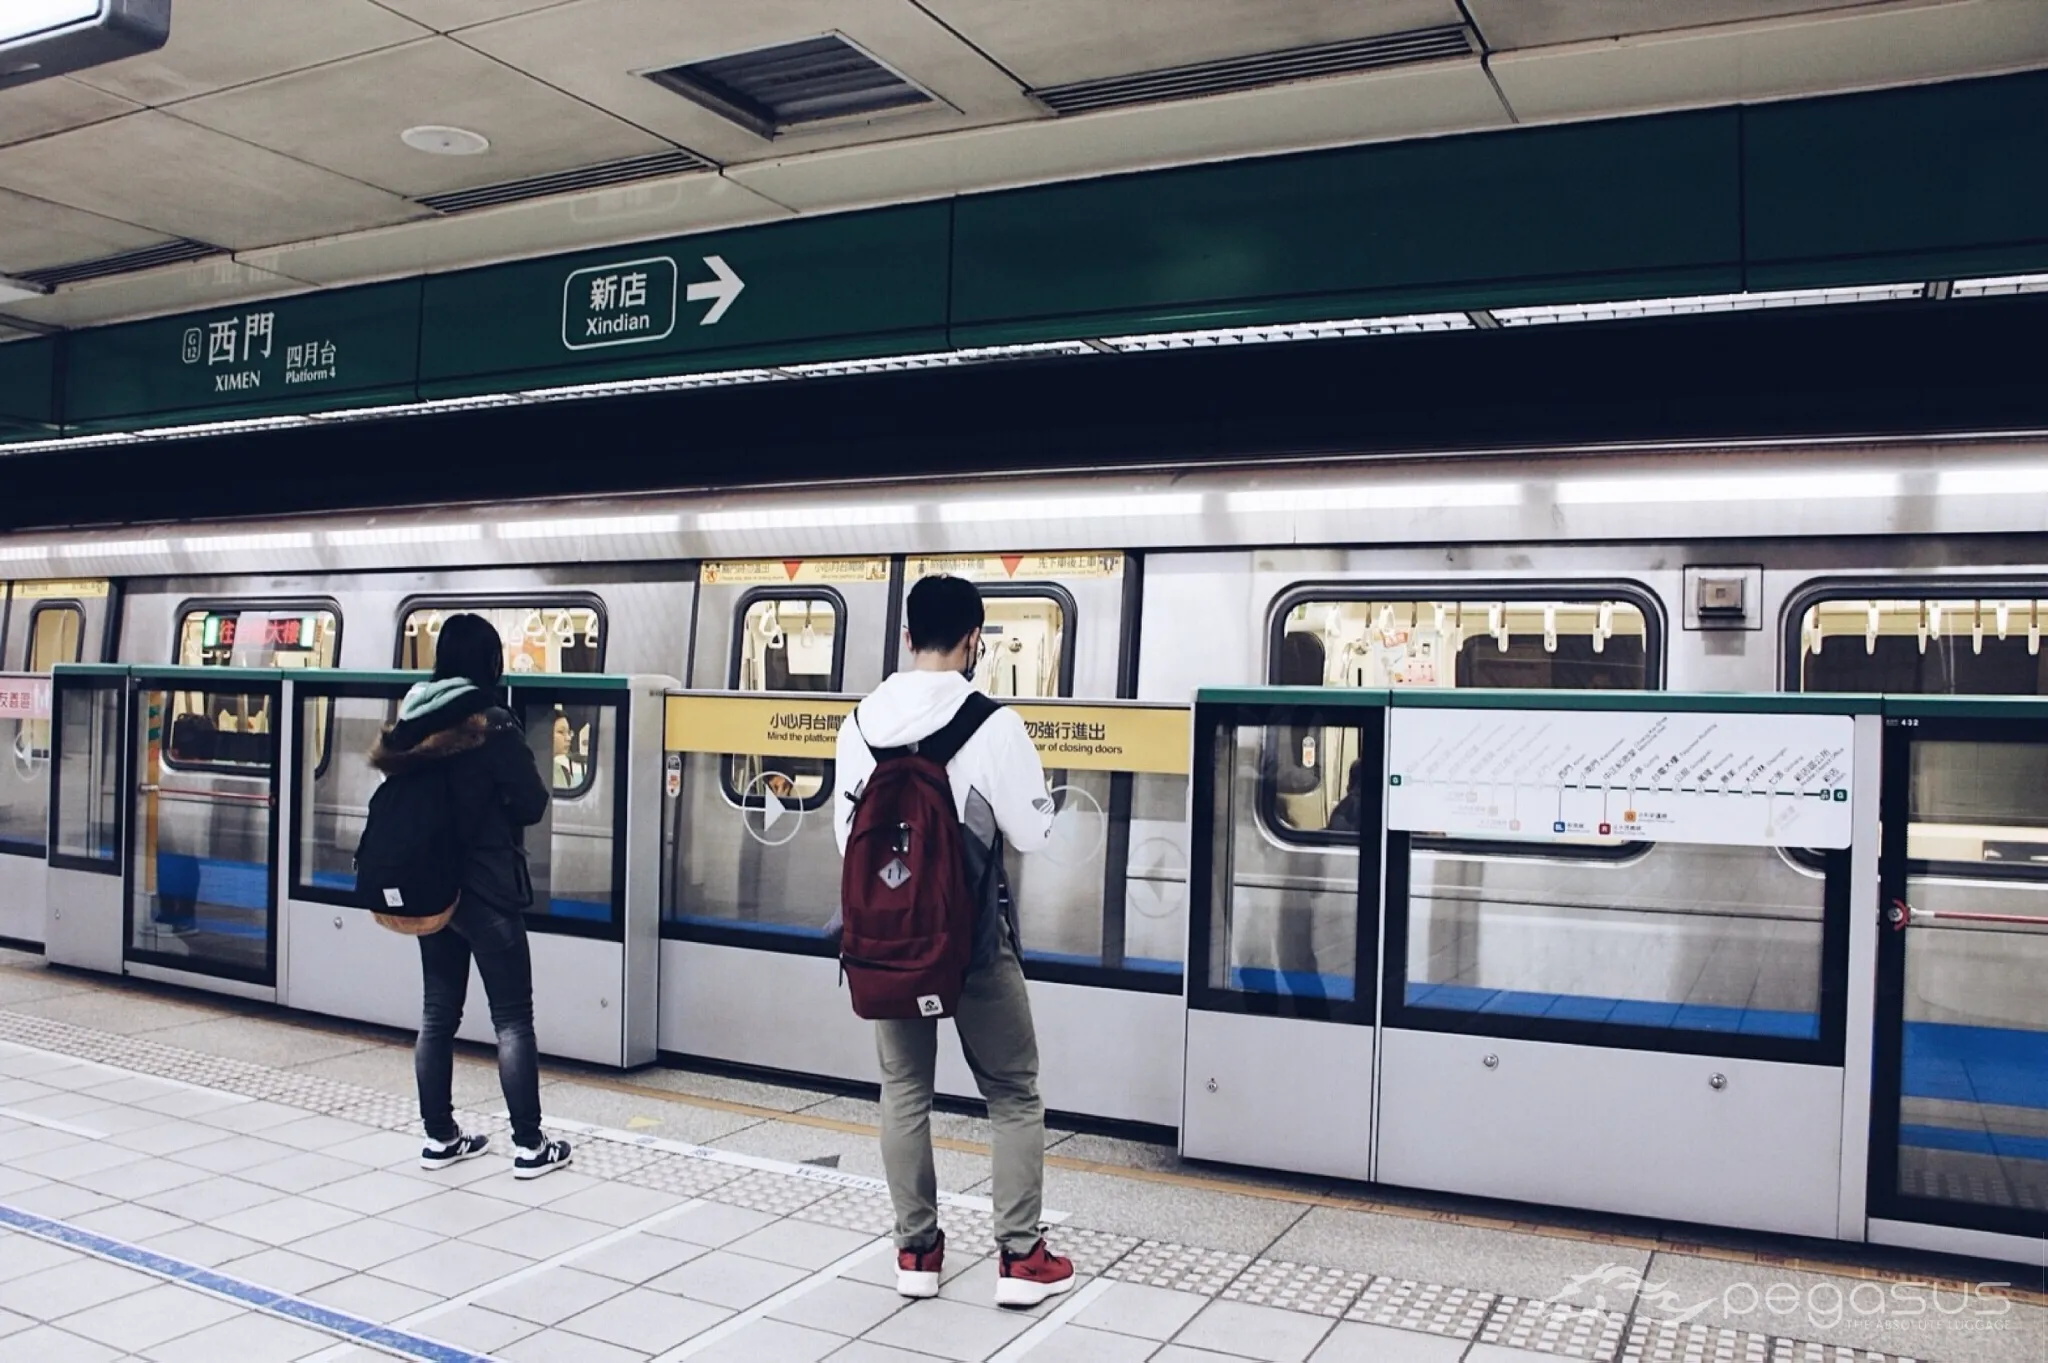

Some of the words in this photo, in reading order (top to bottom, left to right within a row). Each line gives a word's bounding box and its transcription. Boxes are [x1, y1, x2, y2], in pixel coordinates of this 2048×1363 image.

[589, 272, 648, 311] 新店
[586, 313, 650, 336] Xindian
[188, 333, 197, 345] G
[208, 312, 275, 366] 西門
[187, 347, 197, 359] 12
[286, 339, 337, 369] 四月台
[214, 370, 261, 392] XIMEN
[285, 370, 328, 384] Platform
[329, 366, 336, 378] 4
[767, 731, 788, 741] Mind
[789, 732, 803, 742] the
[1048, 742, 1058, 752] of
[1059, 743, 1093, 756] closing
[1095, 744, 1123, 754] doors
[547, 1146, 560, 1162] N
